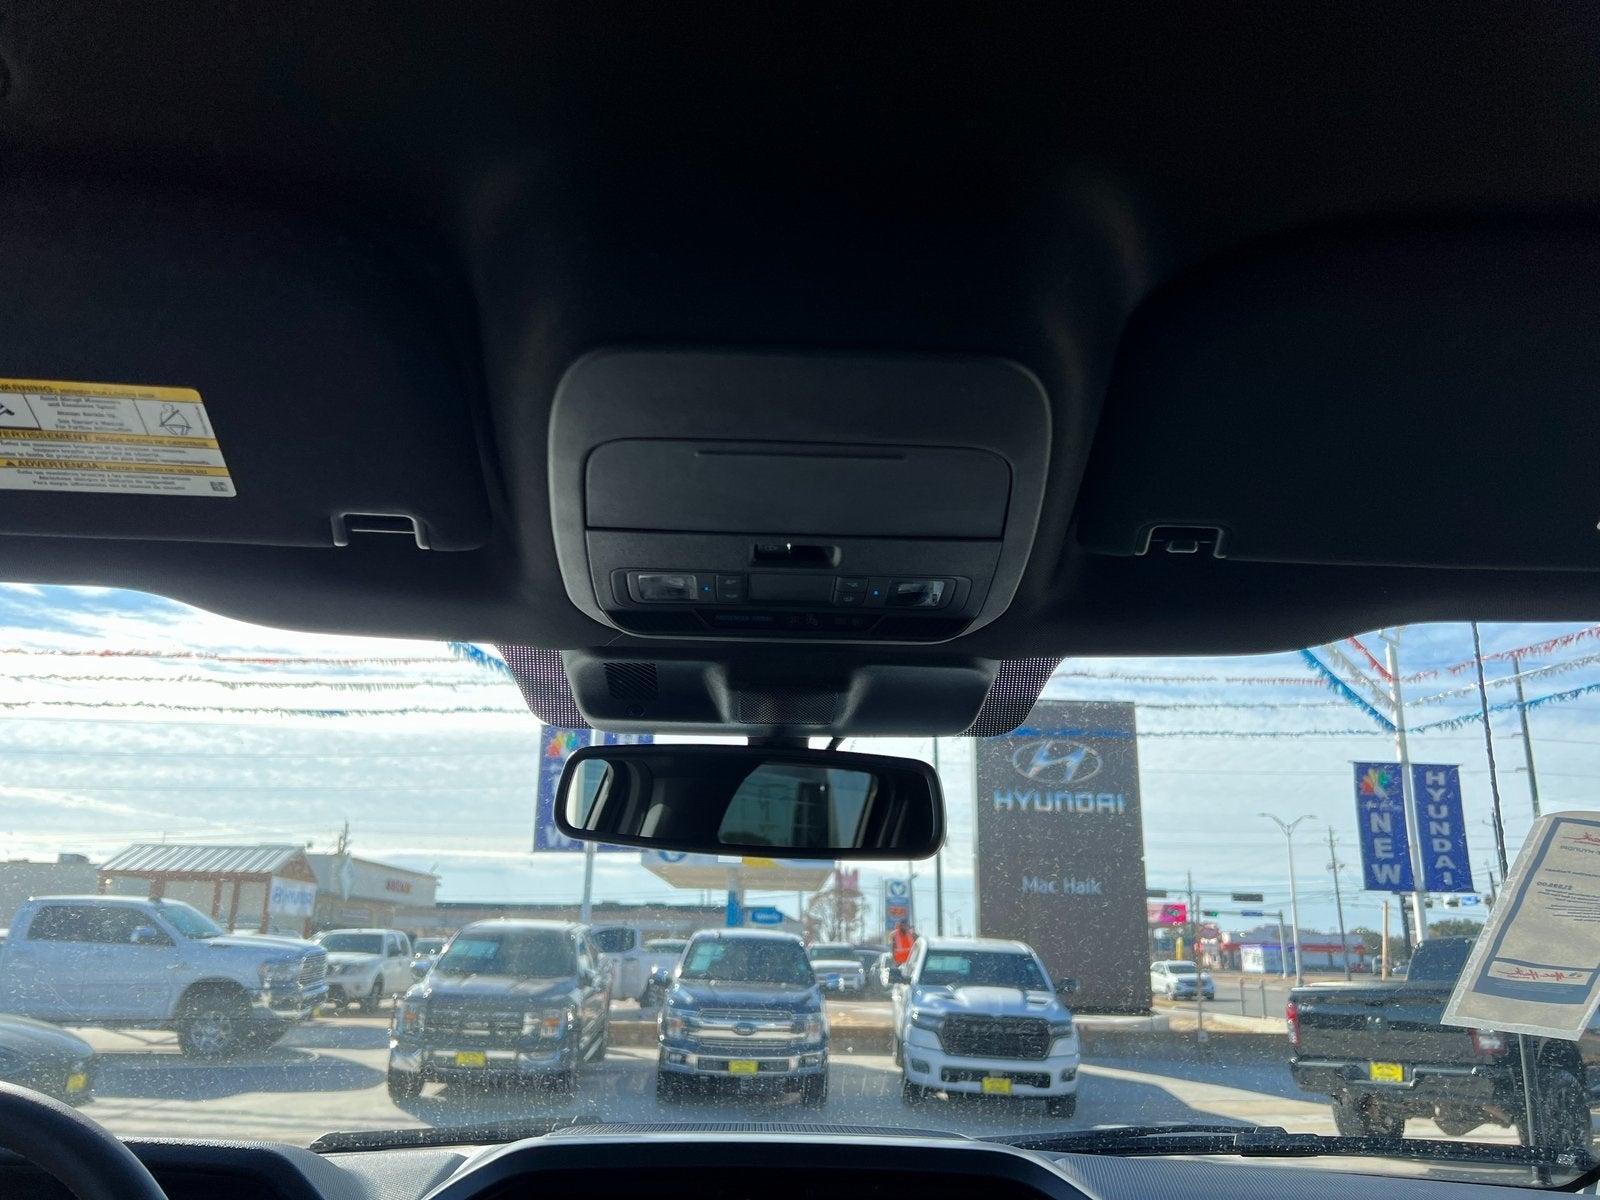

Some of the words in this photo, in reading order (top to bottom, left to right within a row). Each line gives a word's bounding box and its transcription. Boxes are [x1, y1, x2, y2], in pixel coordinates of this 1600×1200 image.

[993, 789, 1126, 815] HYUNDAI
[1370, 812, 1401, 885] NEW
[1425, 771, 1457, 886] HYUNDAI
[1021, 876, 1057, 895] Mac
[1063, 877, 1102, 895] Haik
